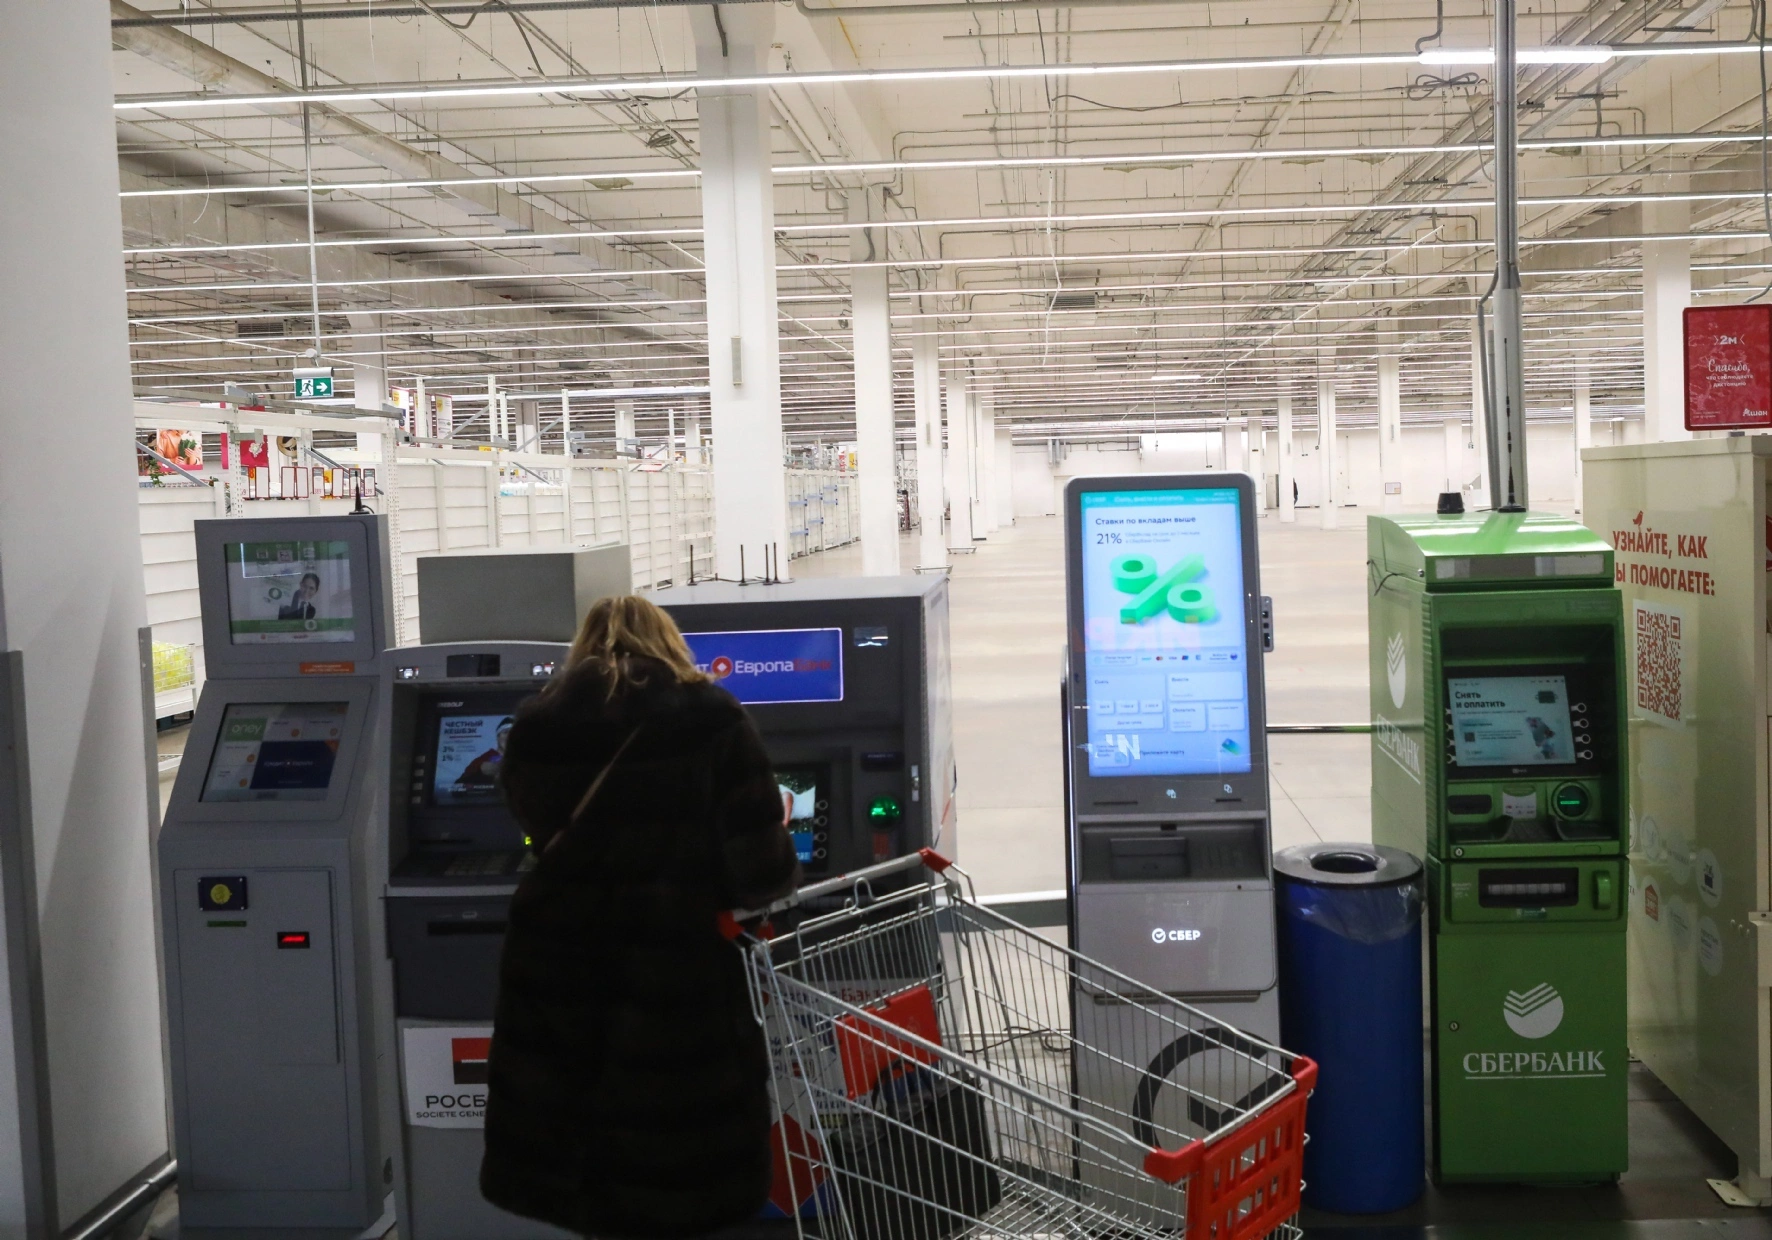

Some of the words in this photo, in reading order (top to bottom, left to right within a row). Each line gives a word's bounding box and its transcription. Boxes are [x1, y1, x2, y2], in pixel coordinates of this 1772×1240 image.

[1708, 359, 1751, 374] Спасибо,
[1095, 517, 1124, 525] Ставки
[1138, 517, 1172, 525] вкладам
[1096, 532, 1123, 545] 21%
[1612, 527, 1673, 560] УЗНАЙТЕ,
[1677, 534, 1708, 559] КАК
[1616, 562, 1626, 583] Ы
[1630, 563, 1715, 596] ПОМОГАЕТЕ:
[1455, 691, 1482, 699] Снять
[1464, 700, 1506, 709] оплатить
[445, 720, 483, 728] ЧЕСТНЫЙ
[1168, 929, 1201, 941] СБЕР
[1463, 1051, 1605, 1074] СБЕРБАНК
[425, 1095, 487, 1109] РОСБ
